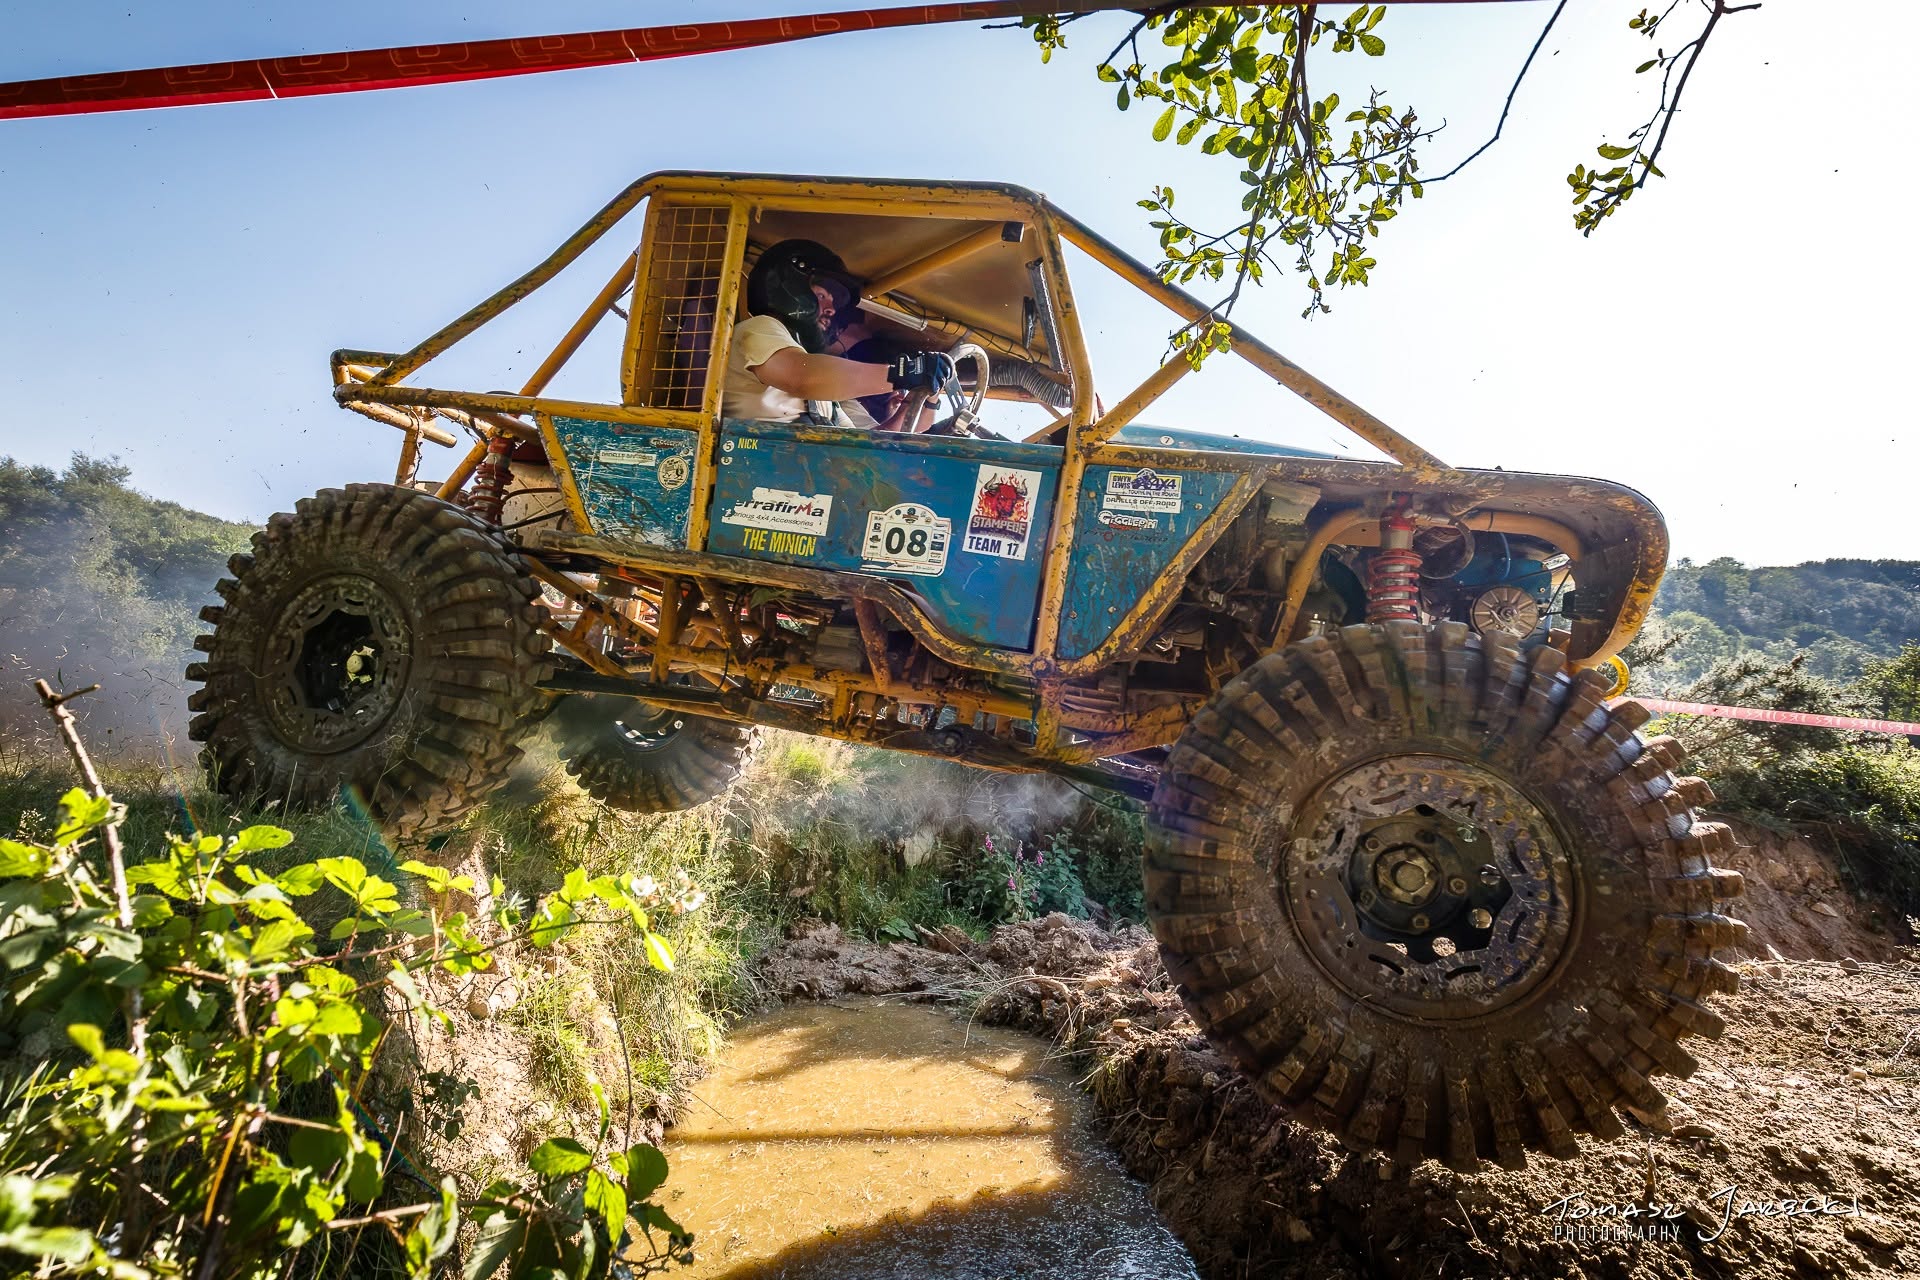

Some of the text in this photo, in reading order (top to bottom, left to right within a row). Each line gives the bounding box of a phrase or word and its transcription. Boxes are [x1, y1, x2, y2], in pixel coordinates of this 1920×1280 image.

[738, 438, 759, 450] NICK
[1111, 481, 1131, 490] LEWIS
[1139, 499, 1177, 508] OFF-ROAD
[769, 514, 814, 527] Accessories
[972, 516, 1026, 535] STAMPEDE
[743, 527, 768, 551] THE
[885, 526, 928, 557] 08
[968, 535, 1002, 554] TEAM
